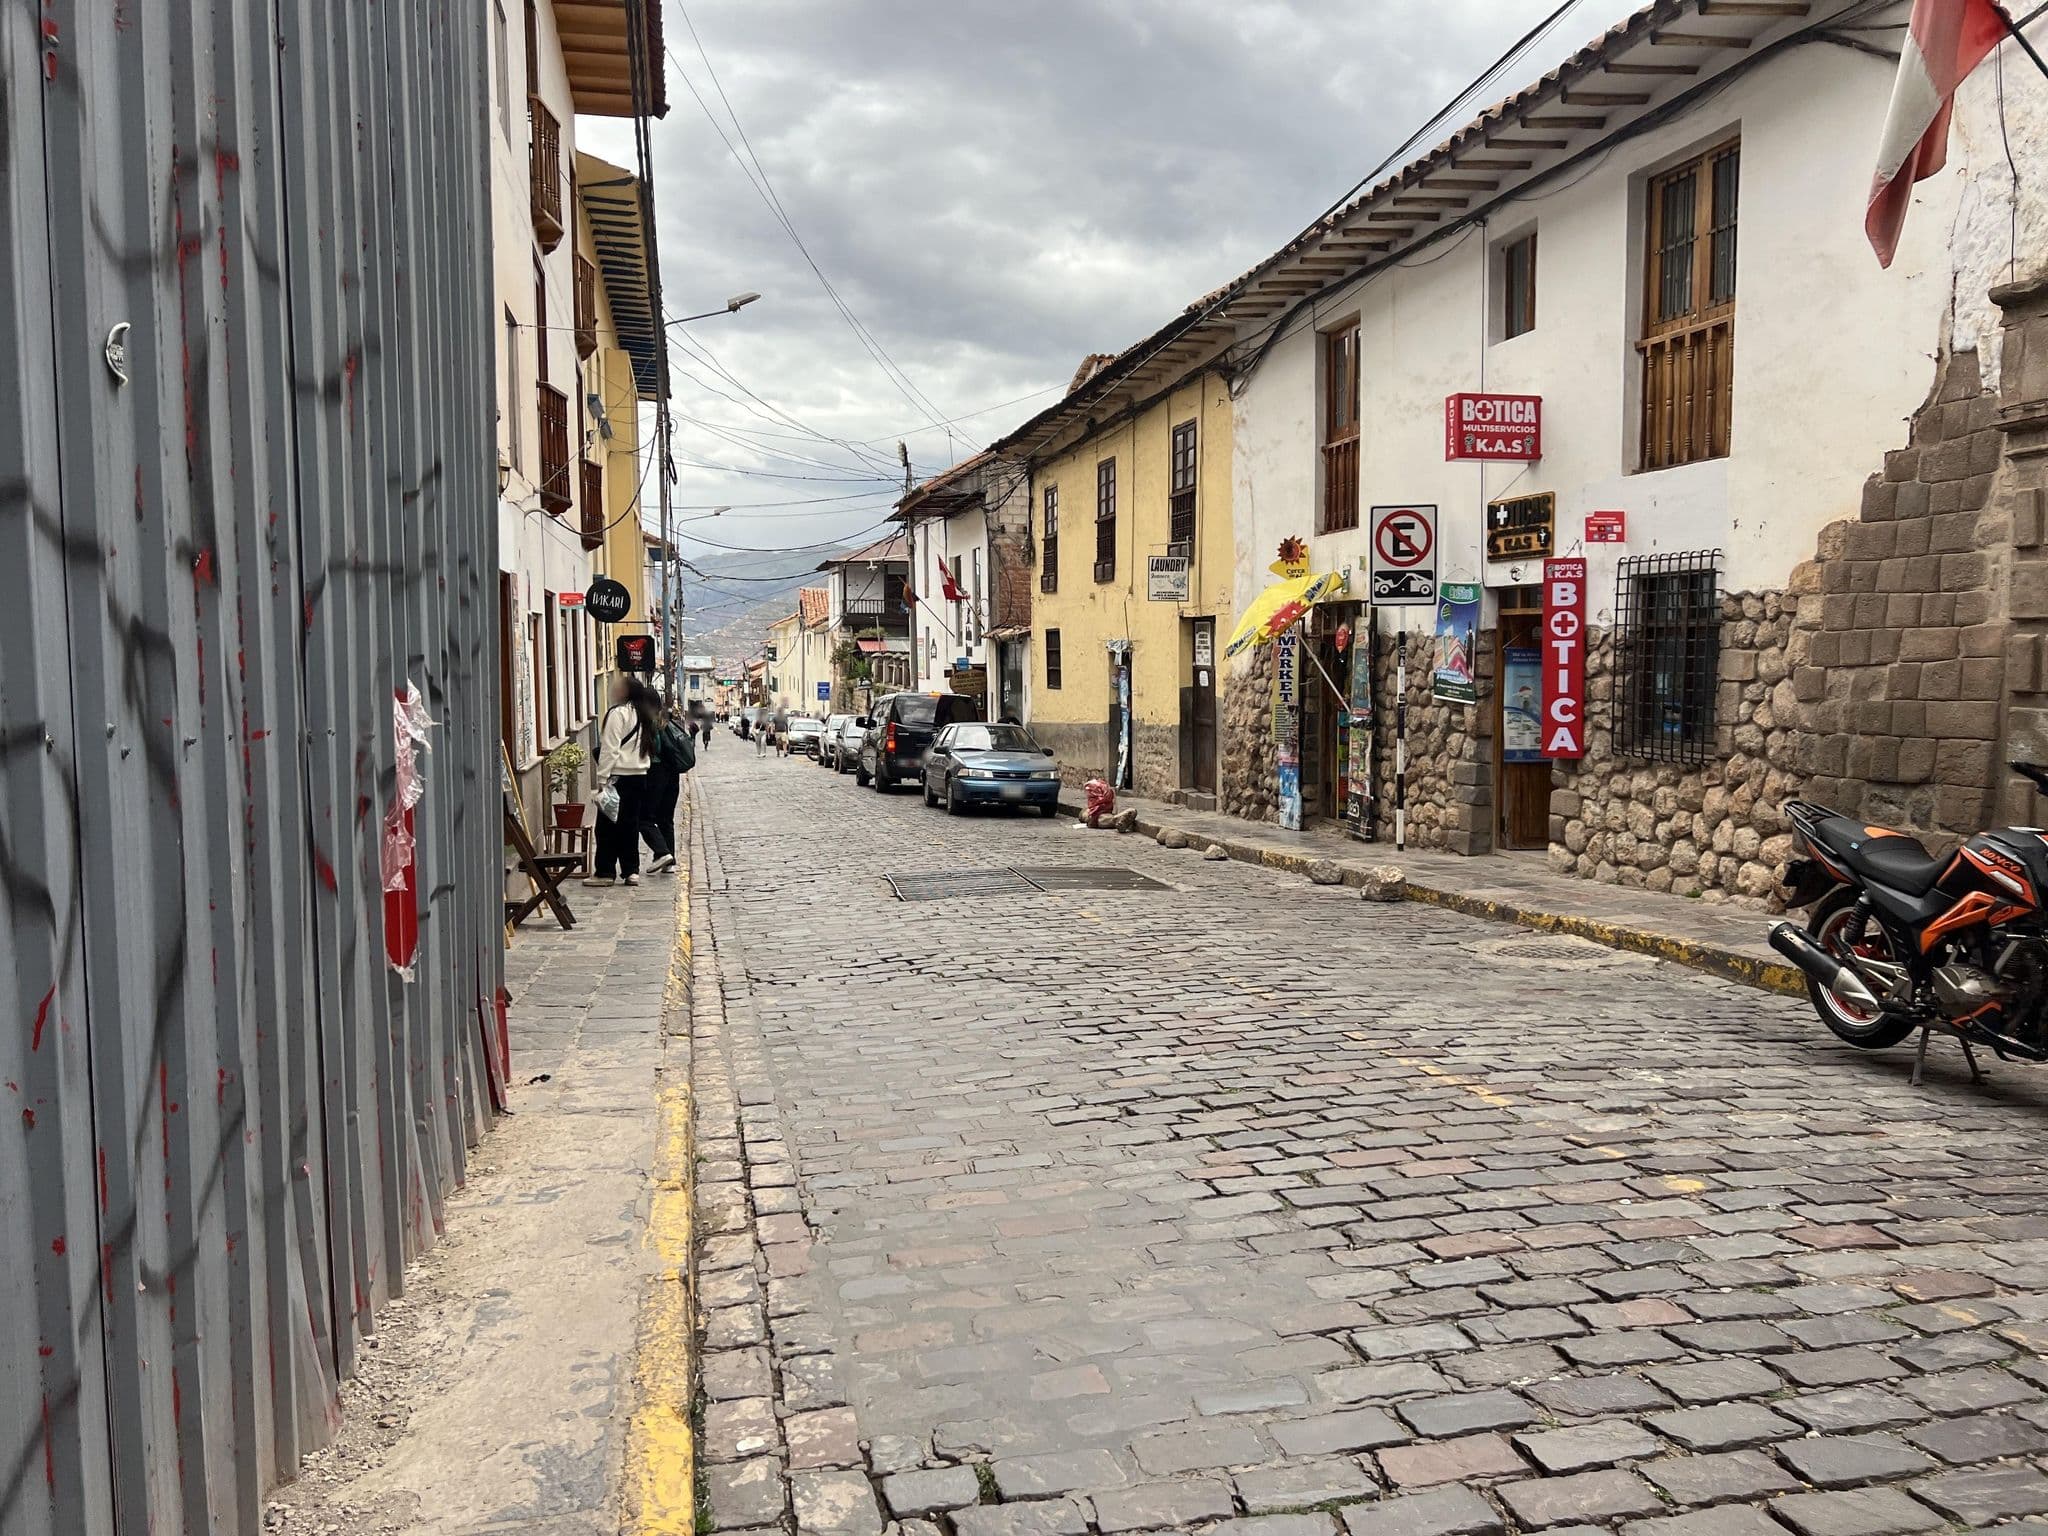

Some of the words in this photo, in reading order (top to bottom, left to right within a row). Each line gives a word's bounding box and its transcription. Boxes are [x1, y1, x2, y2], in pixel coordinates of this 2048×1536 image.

[1462, 399, 1536, 423] BOTICA
[1463, 424, 1536, 433] MULTISERVICIOS
[1476, 438, 1523, 453] K.A.S
[1391, 523, 1415, 557] E
[1151, 559, 1186, 572] LAUNDRY
[1554, 570, 1583, 578] K.A.S
[1278, 635, 1297, 703] MARKET
[1549, 582, 1578, 752] BOTICA
[1979, 849, 2021, 872] RONCO
